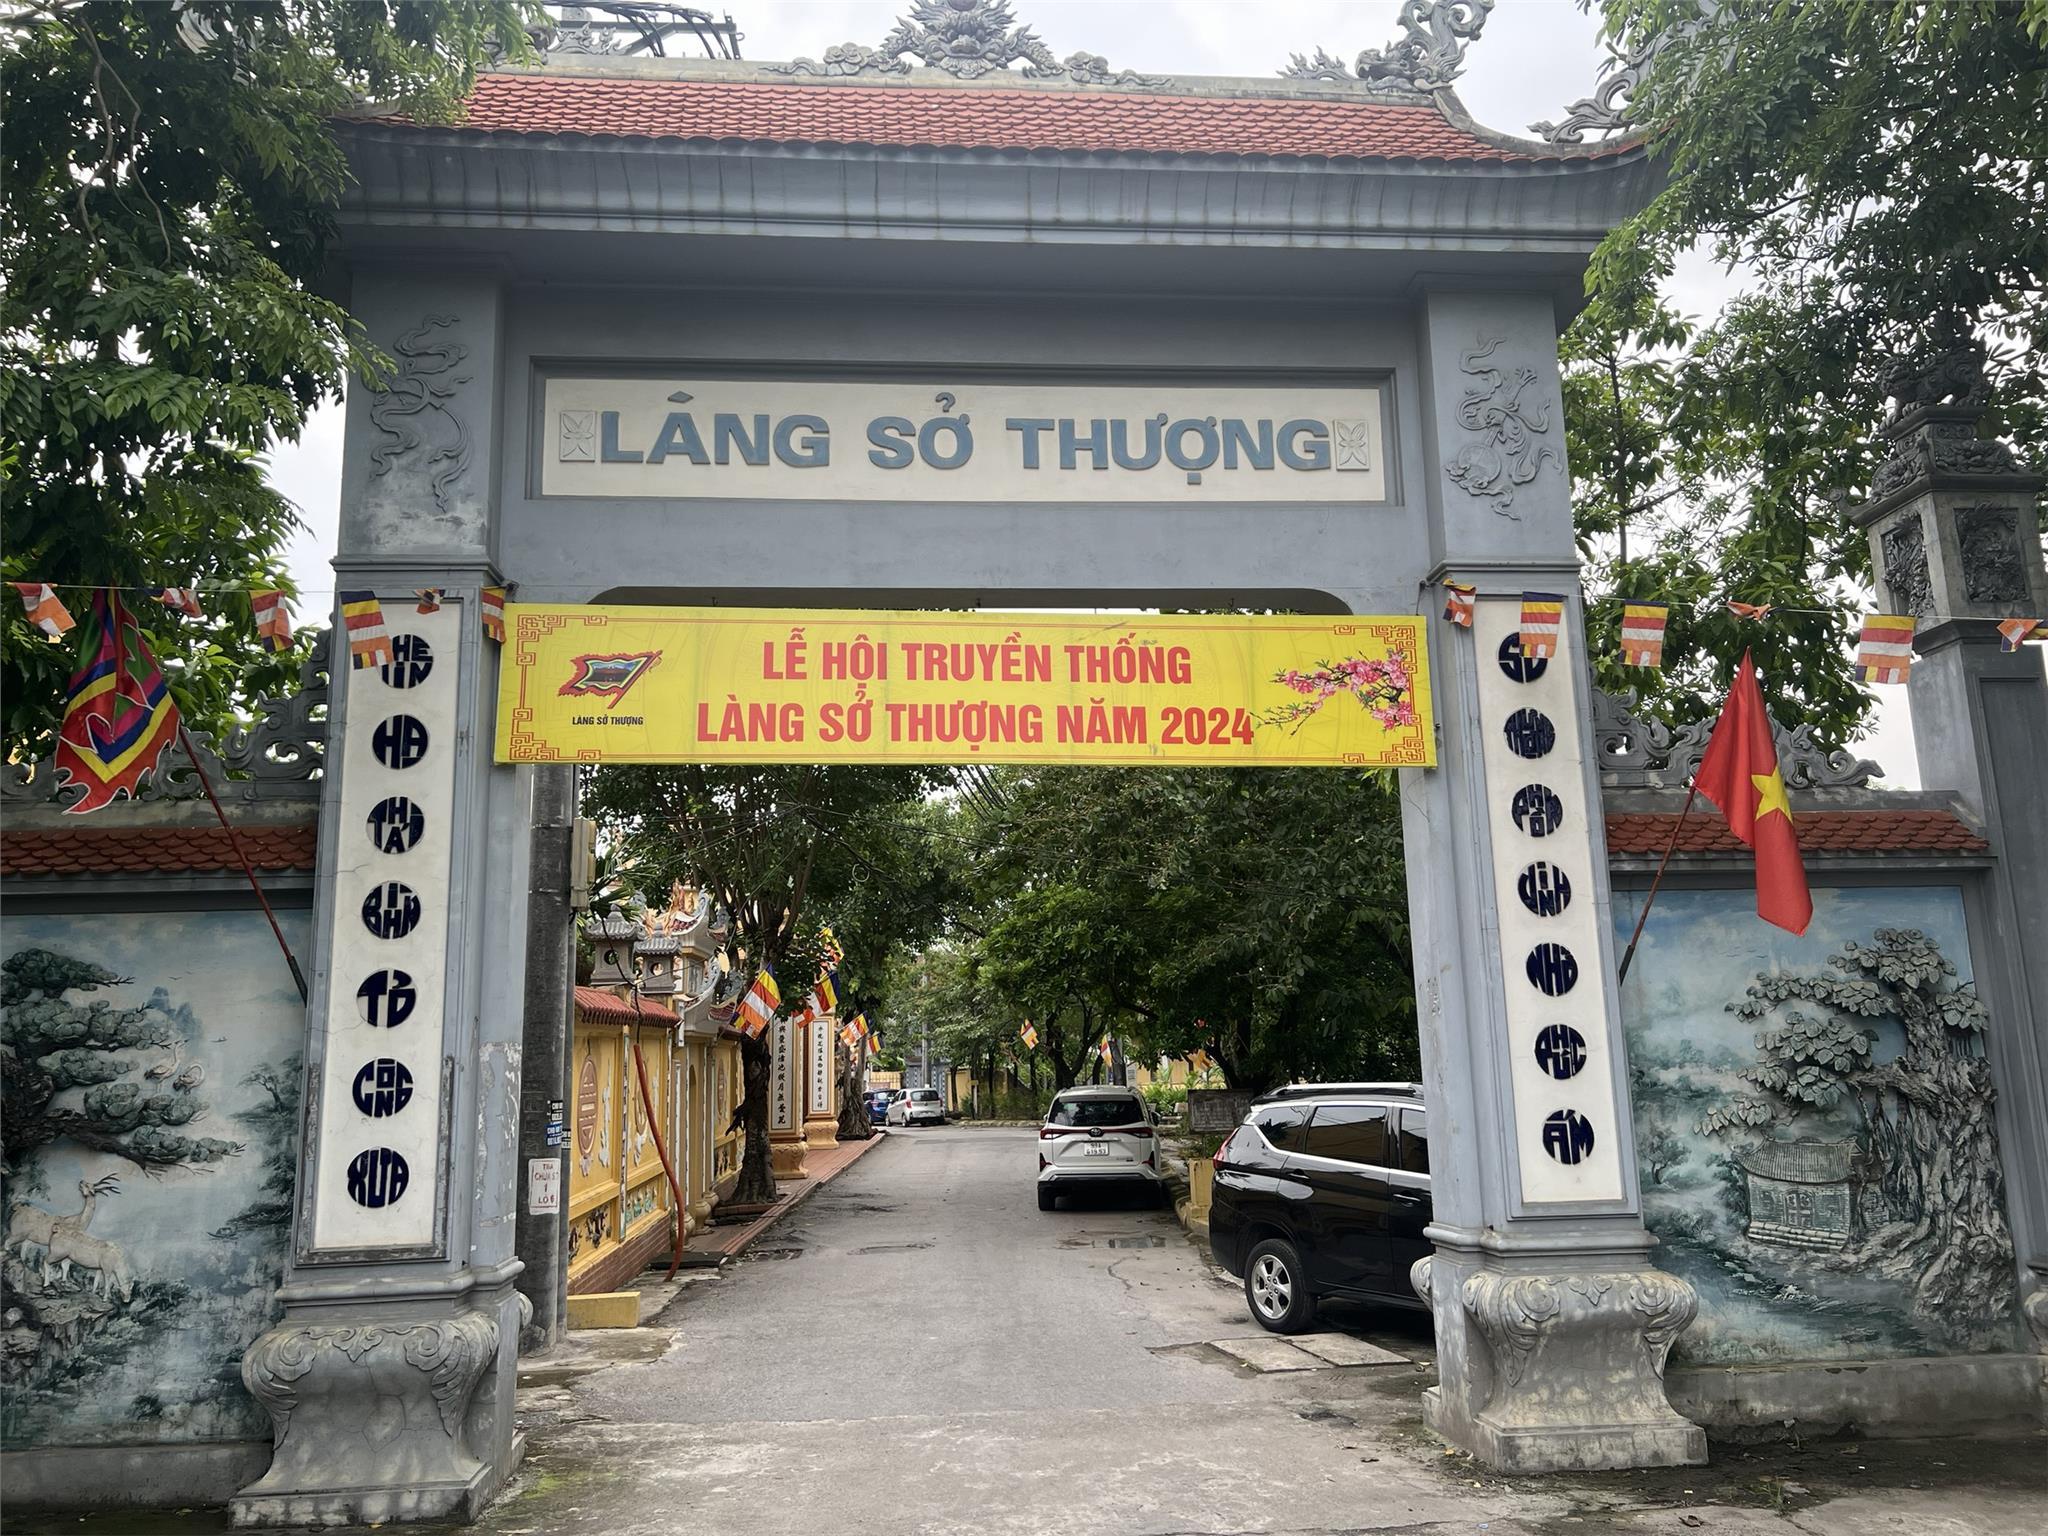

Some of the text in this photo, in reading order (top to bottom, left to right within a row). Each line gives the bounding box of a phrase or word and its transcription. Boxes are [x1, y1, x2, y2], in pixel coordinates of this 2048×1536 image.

[866, 392, 974, 470] SỞ
[1006, 412, 1331, 485] THƯỢNG
[763, 627, 1192, 689] LỄ HỘI TRUYỀN THỐNG
[572, 713, 645, 728] LÀNG SỞ THƯỢNG
[697, 690, 1255, 751] LÀNG SỞ THƯỢNG NĂM 2024
